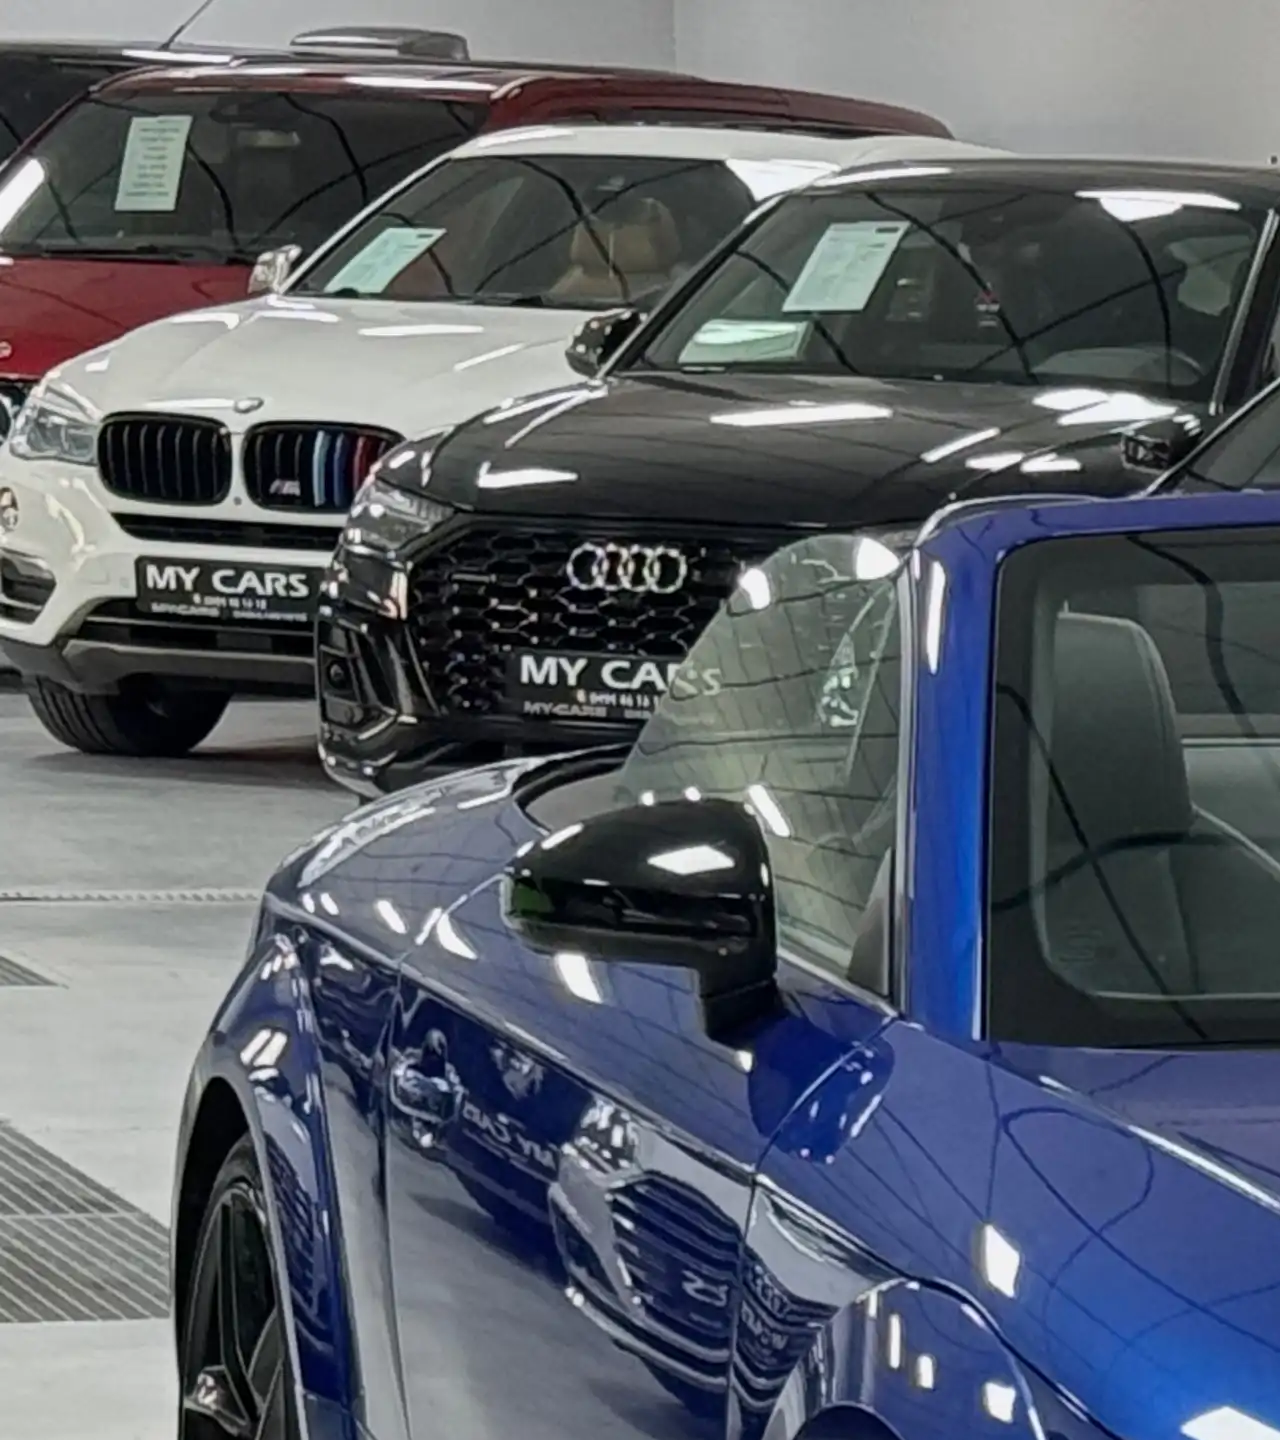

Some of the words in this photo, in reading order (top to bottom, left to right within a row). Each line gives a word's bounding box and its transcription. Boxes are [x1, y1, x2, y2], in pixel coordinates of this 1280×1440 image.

[146, 564, 200, 591] MY
[211, 569, 309, 598] CARS
[520, 655, 588, 686] MY
